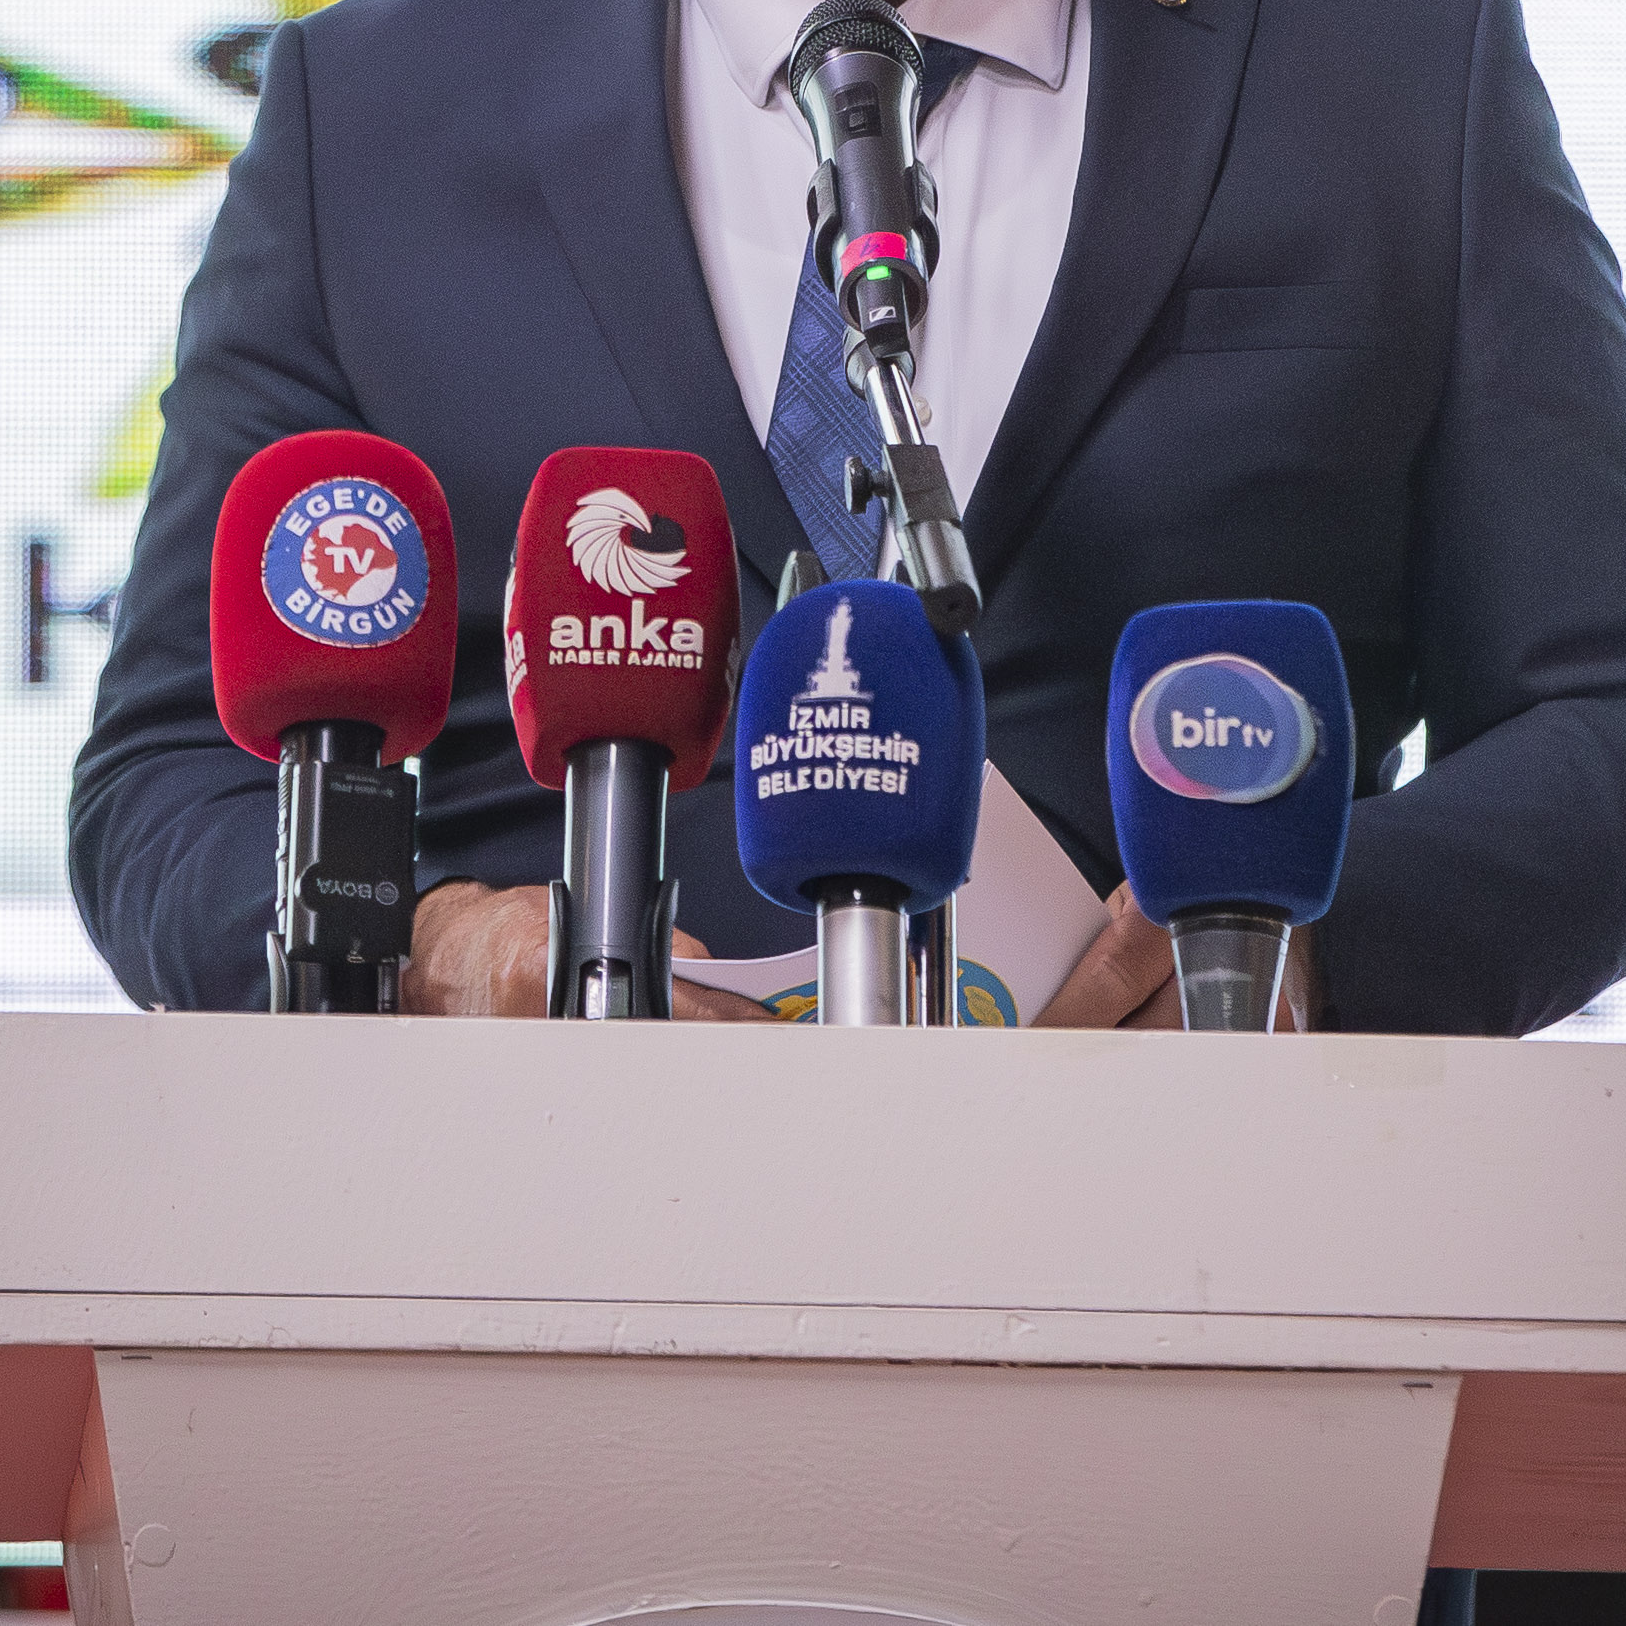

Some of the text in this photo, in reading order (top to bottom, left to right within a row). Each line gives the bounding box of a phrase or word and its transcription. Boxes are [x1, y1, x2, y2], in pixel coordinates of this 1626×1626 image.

[285, 487, 408, 537] EGE'DE
[324, 546, 375, 574] TV
[285, 587, 416, 635] BİRGÜN
[549, 598, 704, 654] anka
[789, 702, 871, 731] İZMİR
[750, 730, 921, 771] BÜYÜKŞEHİR
[757, 761, 909, 800] BELEDİYESİ
